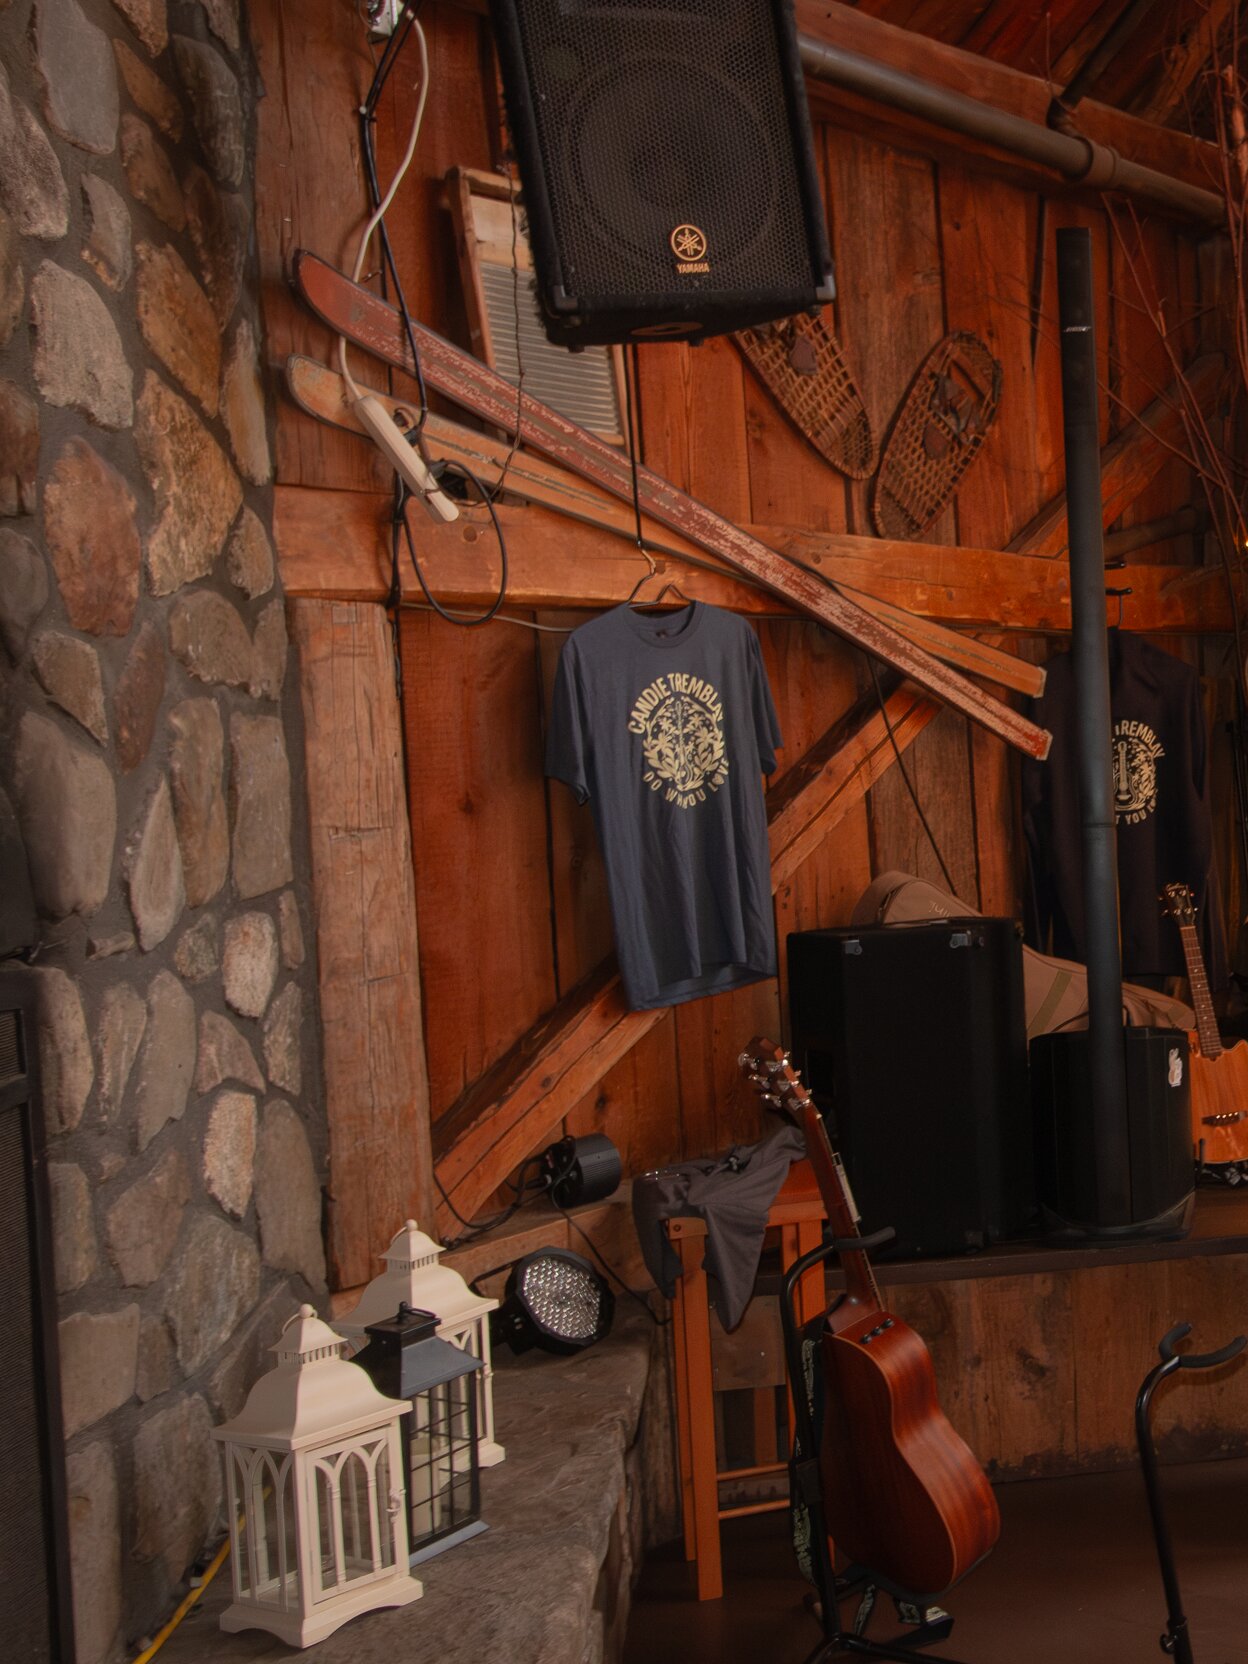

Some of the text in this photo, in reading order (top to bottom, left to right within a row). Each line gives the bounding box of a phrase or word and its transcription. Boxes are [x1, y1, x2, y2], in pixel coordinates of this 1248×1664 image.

[676, 262, 710, 274] YAMAHA
[627, 672, 724, 735] CANDIE TREMBLA
